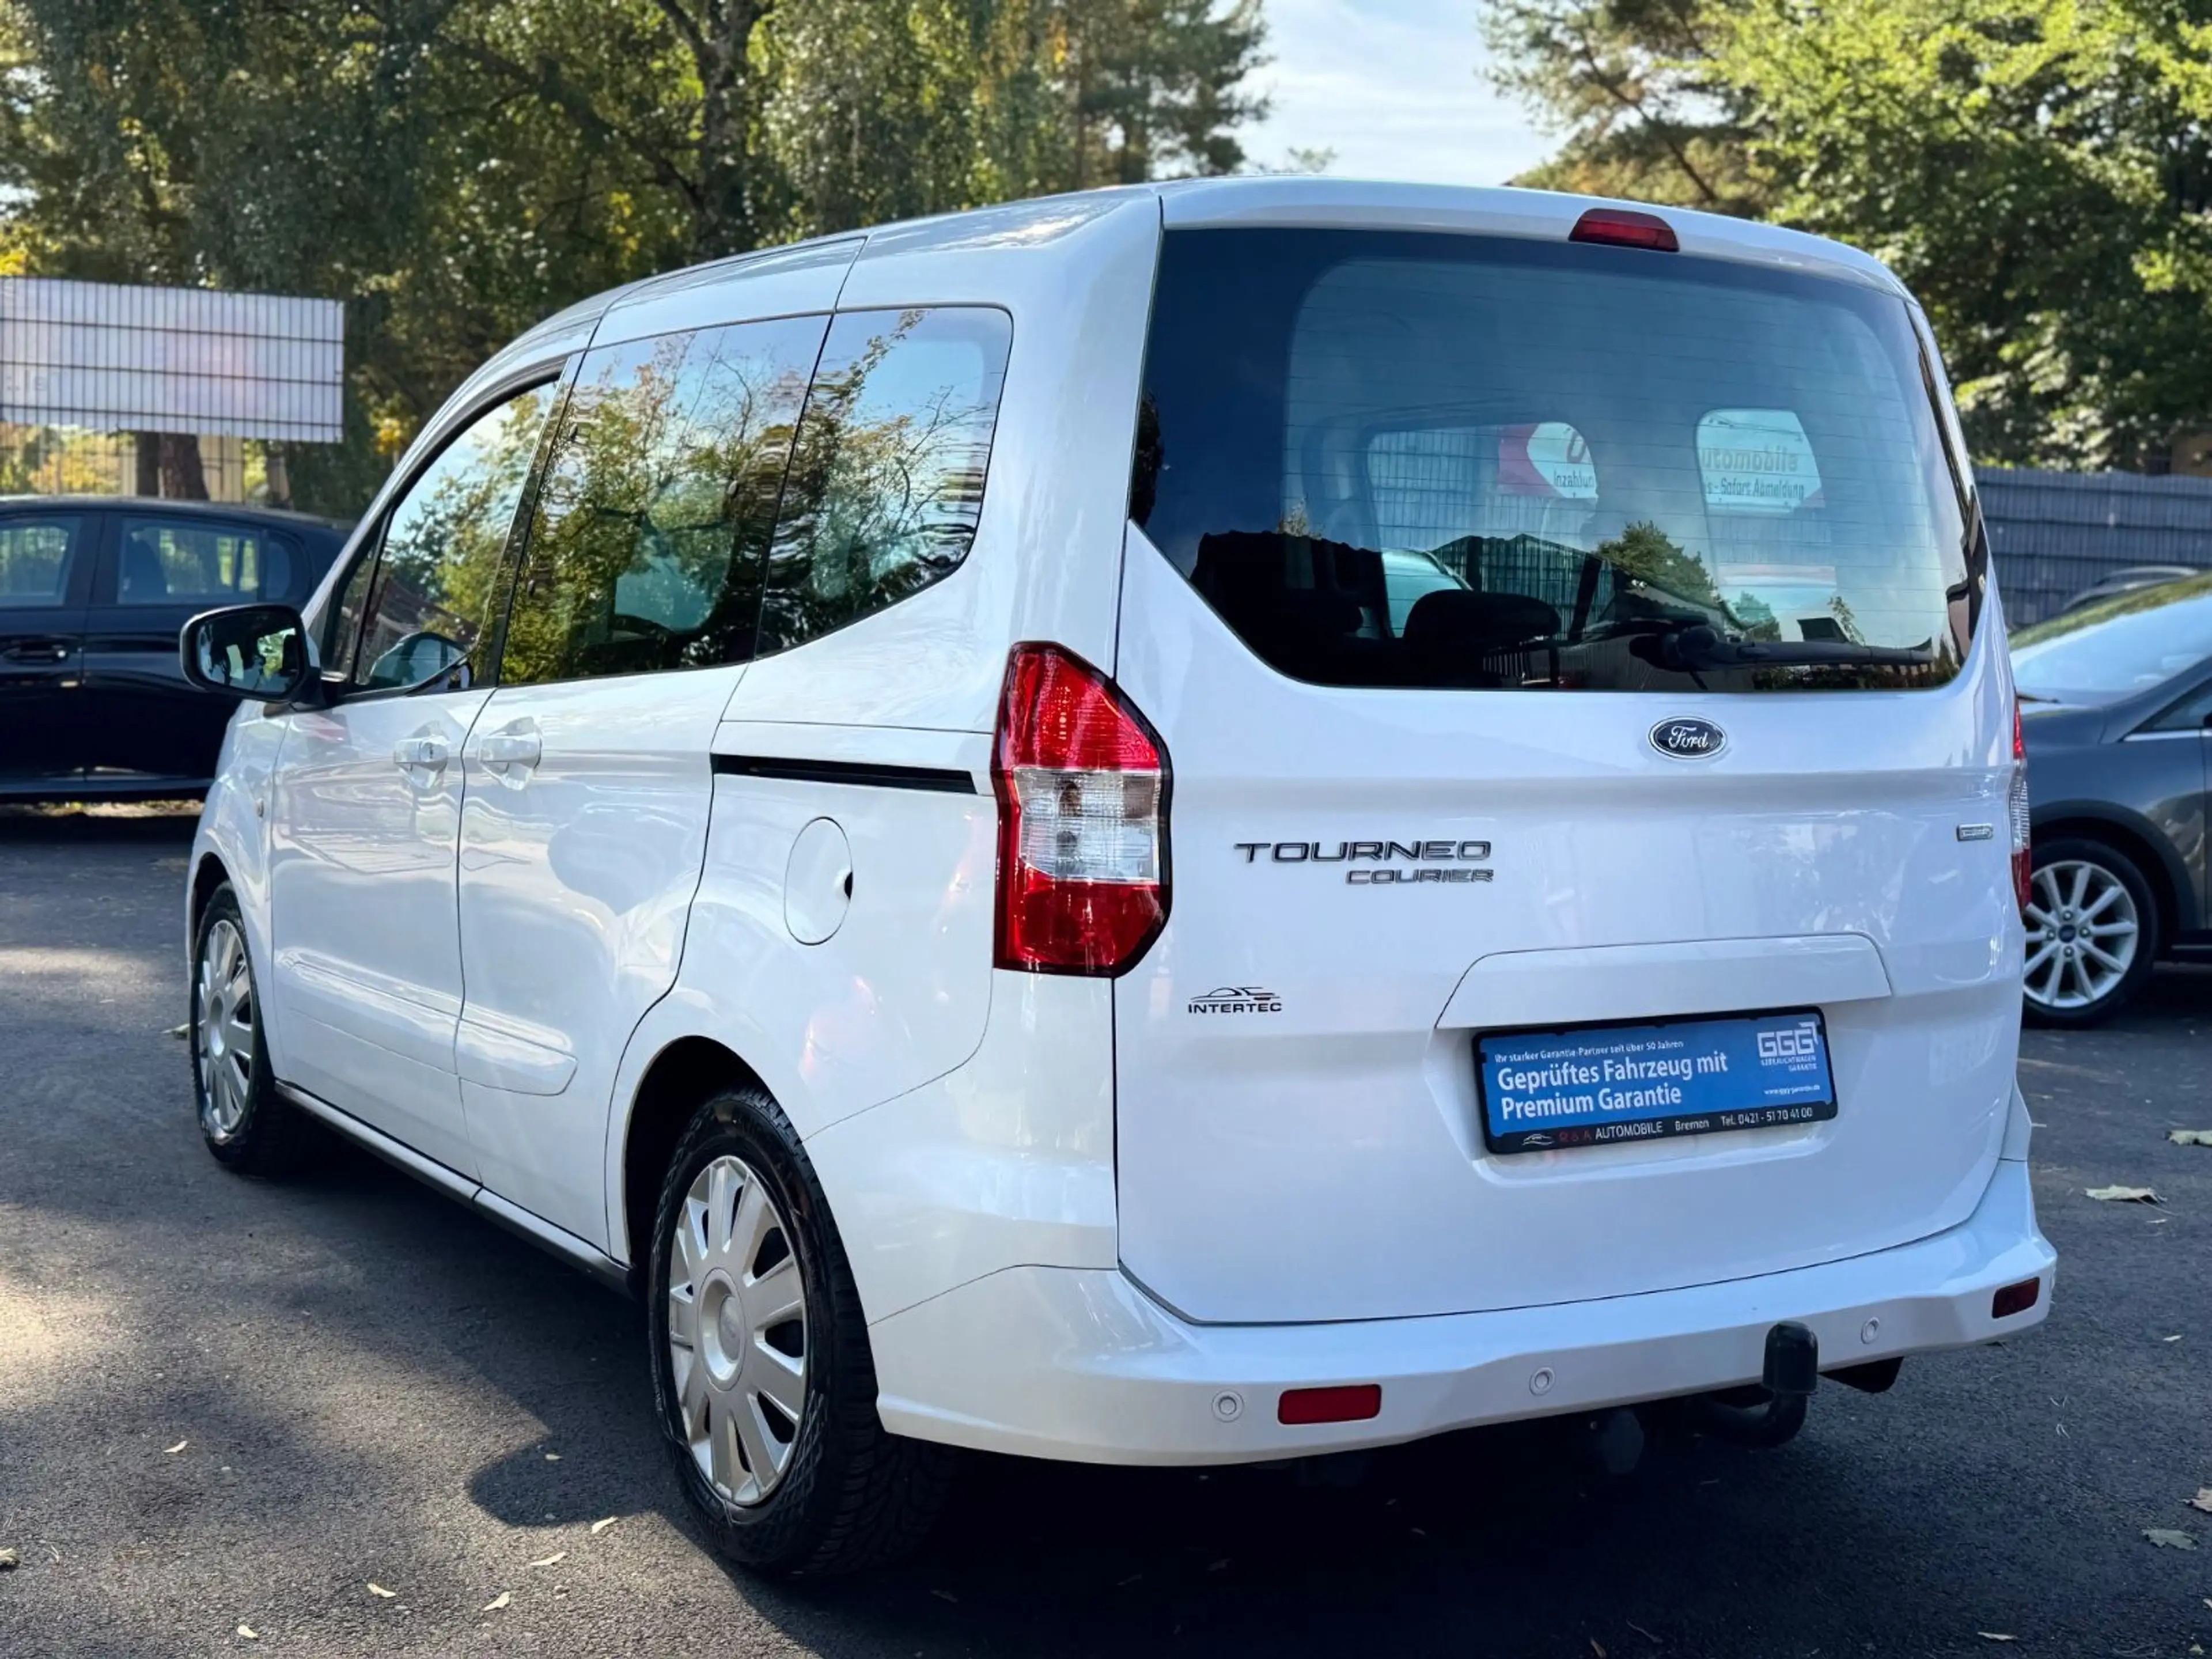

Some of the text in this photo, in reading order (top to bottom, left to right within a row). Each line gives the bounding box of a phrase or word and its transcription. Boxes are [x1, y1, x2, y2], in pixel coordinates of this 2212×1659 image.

[1721, 476, 1752, 496] Sofort
[1753, 478, 1804, 501] Abmeldung
[1669, 726, 1709, 748] Ford
[1233, 840, 1491, 863] TOURNEO
[1345, 868, 1494, 885] COURIER
[1188, 1002, 1283, 1014] INTERTEC
[1509, 1051, 1539, 1062] starker
[1610, 1044, 1625, 1054] seit
[1626, 1043, 1644, 1052] über
[1646, 1041, 1656, 1050] 50
[1657, 1040, 1684, 1050] Jahren
[1498, 1050, 1728, 1094] Geprüftes Fahrzeug mit
[1501, 1082, 1681, 1120] Premium Garantie
[1595, 1120, 1664, 1140] AUTOMOBILE
[1675, 1119, 1710, 1132] Bremen
[1738, 1112, 1759, 1126] 0421
